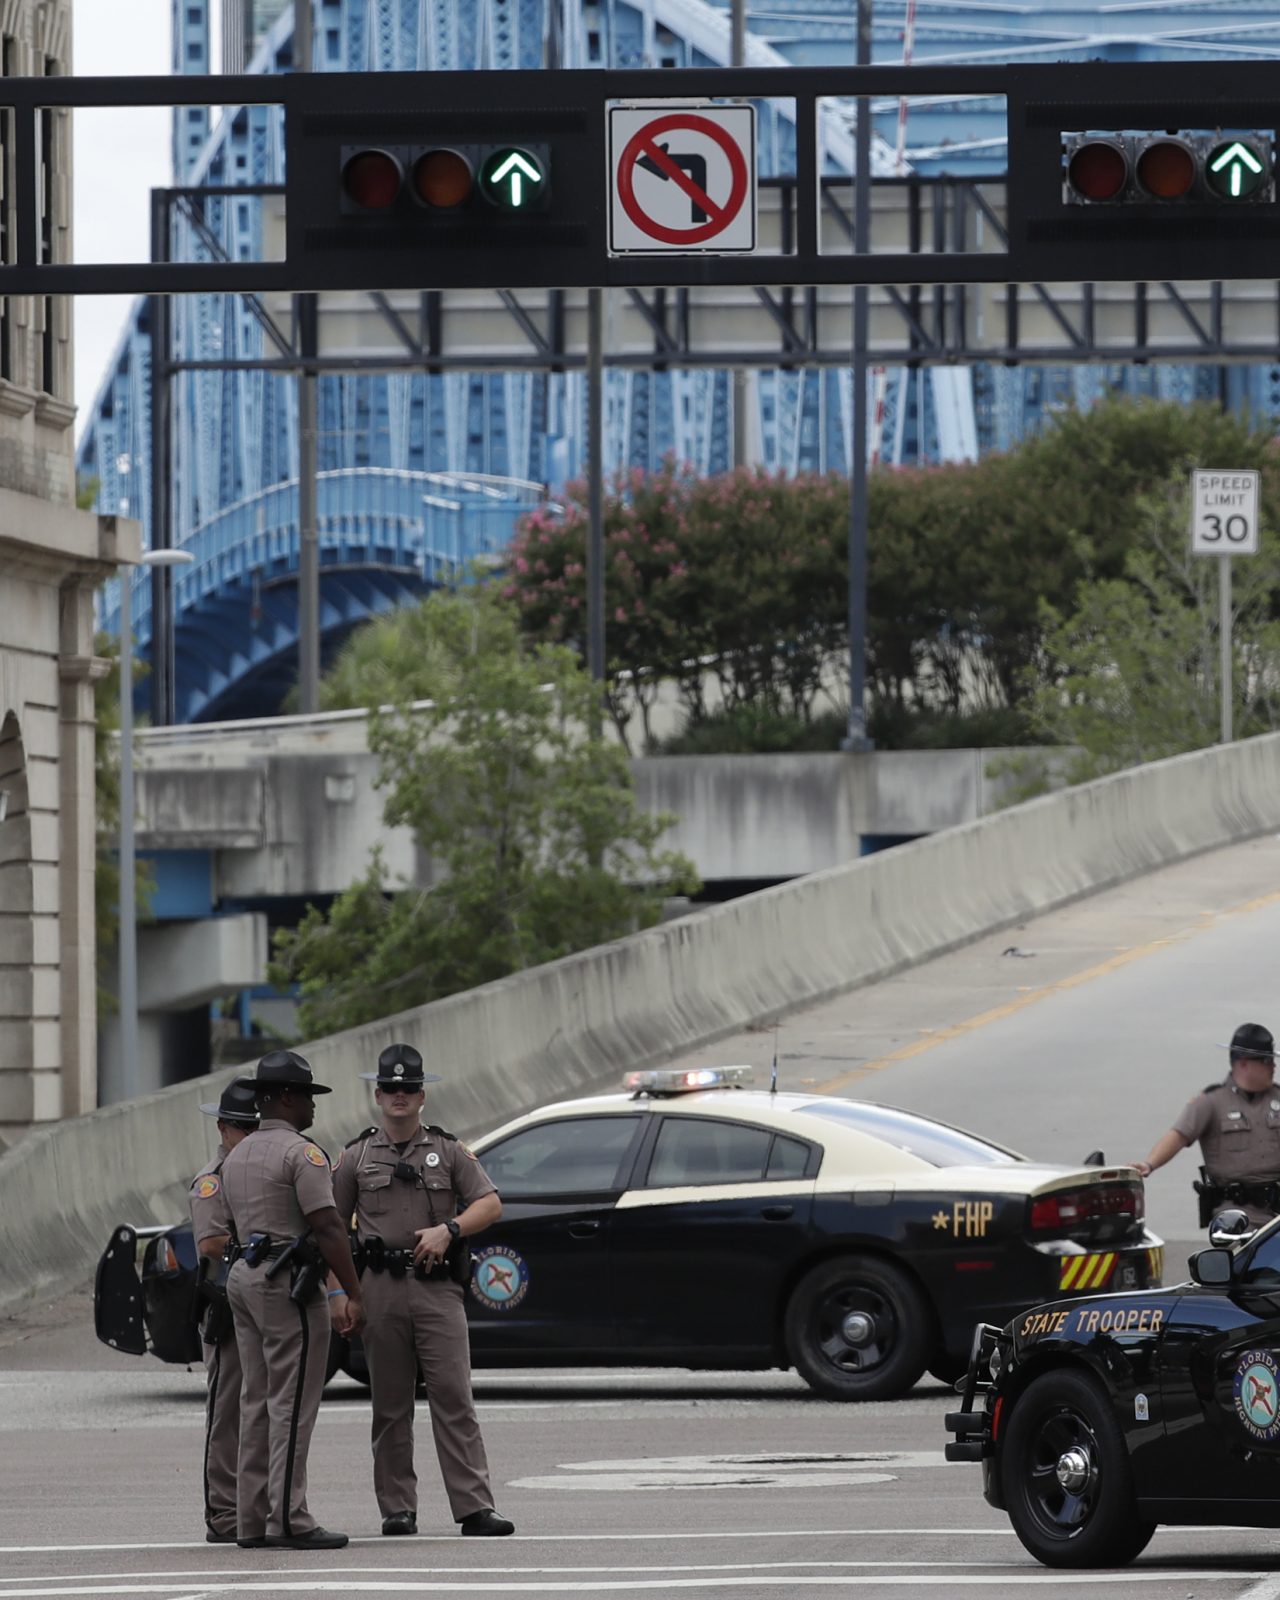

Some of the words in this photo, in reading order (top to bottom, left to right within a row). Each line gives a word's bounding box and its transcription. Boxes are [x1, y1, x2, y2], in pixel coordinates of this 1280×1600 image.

[1200, 476, 1252, 490] SPEED
[1204, 493, 1246, 506] LIMIT
[1201, 513, 1249, 543] 30
[1020, 1311, 1071, 1337] STATE
[1076, 1310, 1164, 1333] TROOPER
[1237, 1351, 1280, 1377] FLORIDA
[1234, 1396, 1268, 1439] HIGHWAY
